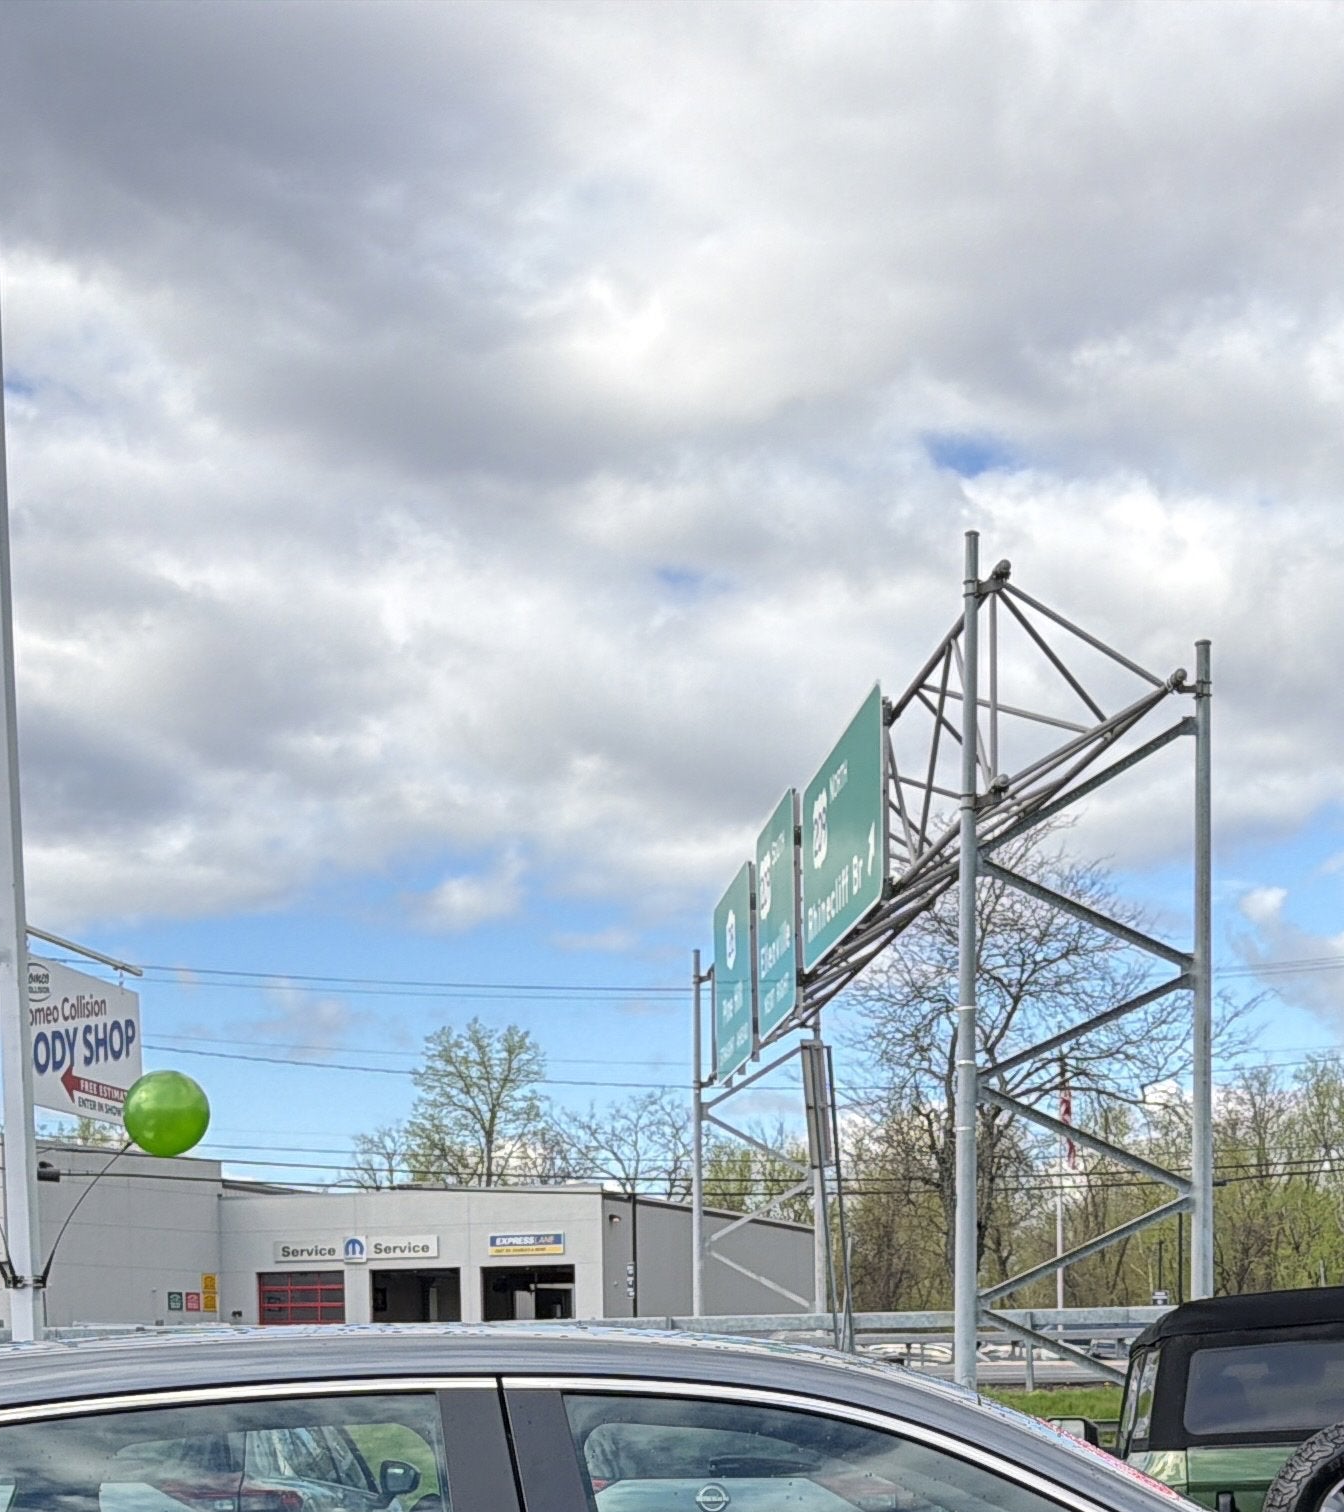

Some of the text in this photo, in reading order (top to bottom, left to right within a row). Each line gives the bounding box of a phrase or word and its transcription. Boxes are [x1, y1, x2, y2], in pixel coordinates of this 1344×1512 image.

[29, 994, 107, 1026] omeo Collision
[34, 1018, 136, 1075] ODY SHOP
[80, 1079, 98, 1095] FREE
[105, 1103, 122, 1117] SHOW
[496, 1236, 535, 1246] EXPRESS
[281, 1245, 336, 1258] Service
[374, 1242, 430, 1255] Service
